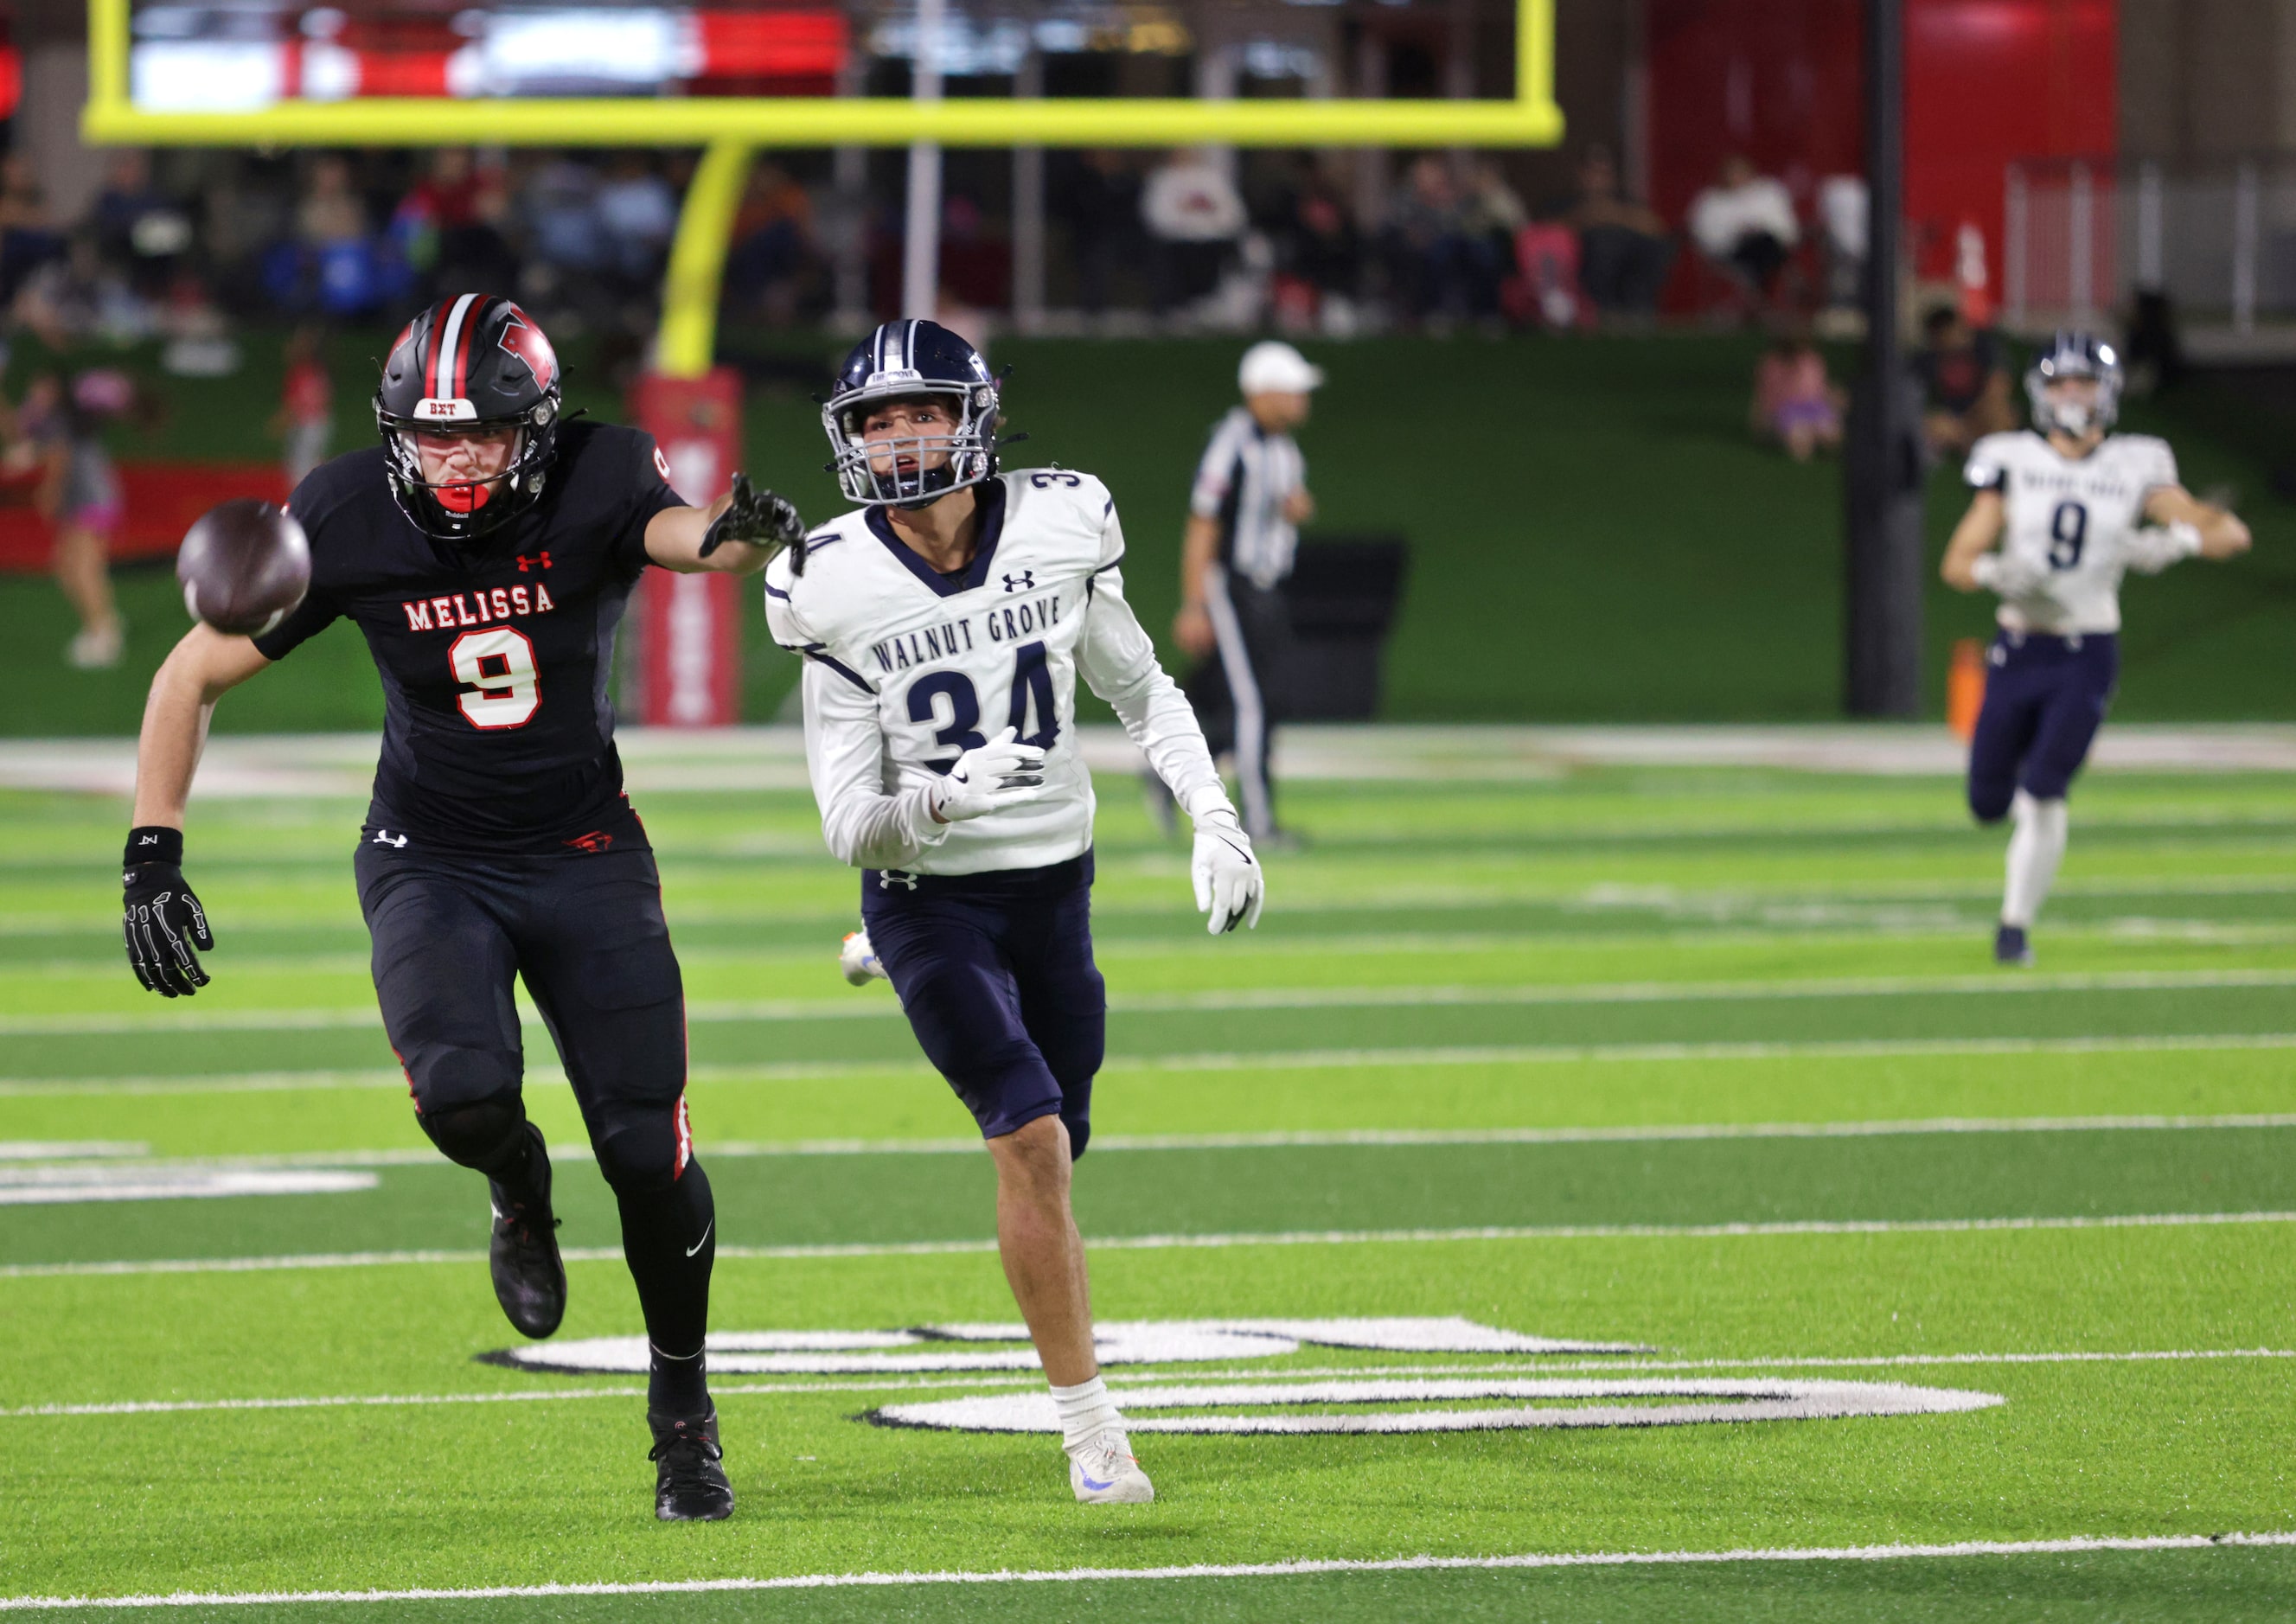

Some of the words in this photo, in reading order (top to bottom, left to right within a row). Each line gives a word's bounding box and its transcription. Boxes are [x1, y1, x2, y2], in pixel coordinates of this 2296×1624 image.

[2048, 500, 2088, 571] 9
[402, 582, 555, 631] MELISSA
[873, 618, 973, 673] WALNUT
[988, 596, 1060, 642] GROVE
[447, 624, 543, 730] 9
[905, 640, 1062, 777] 34
